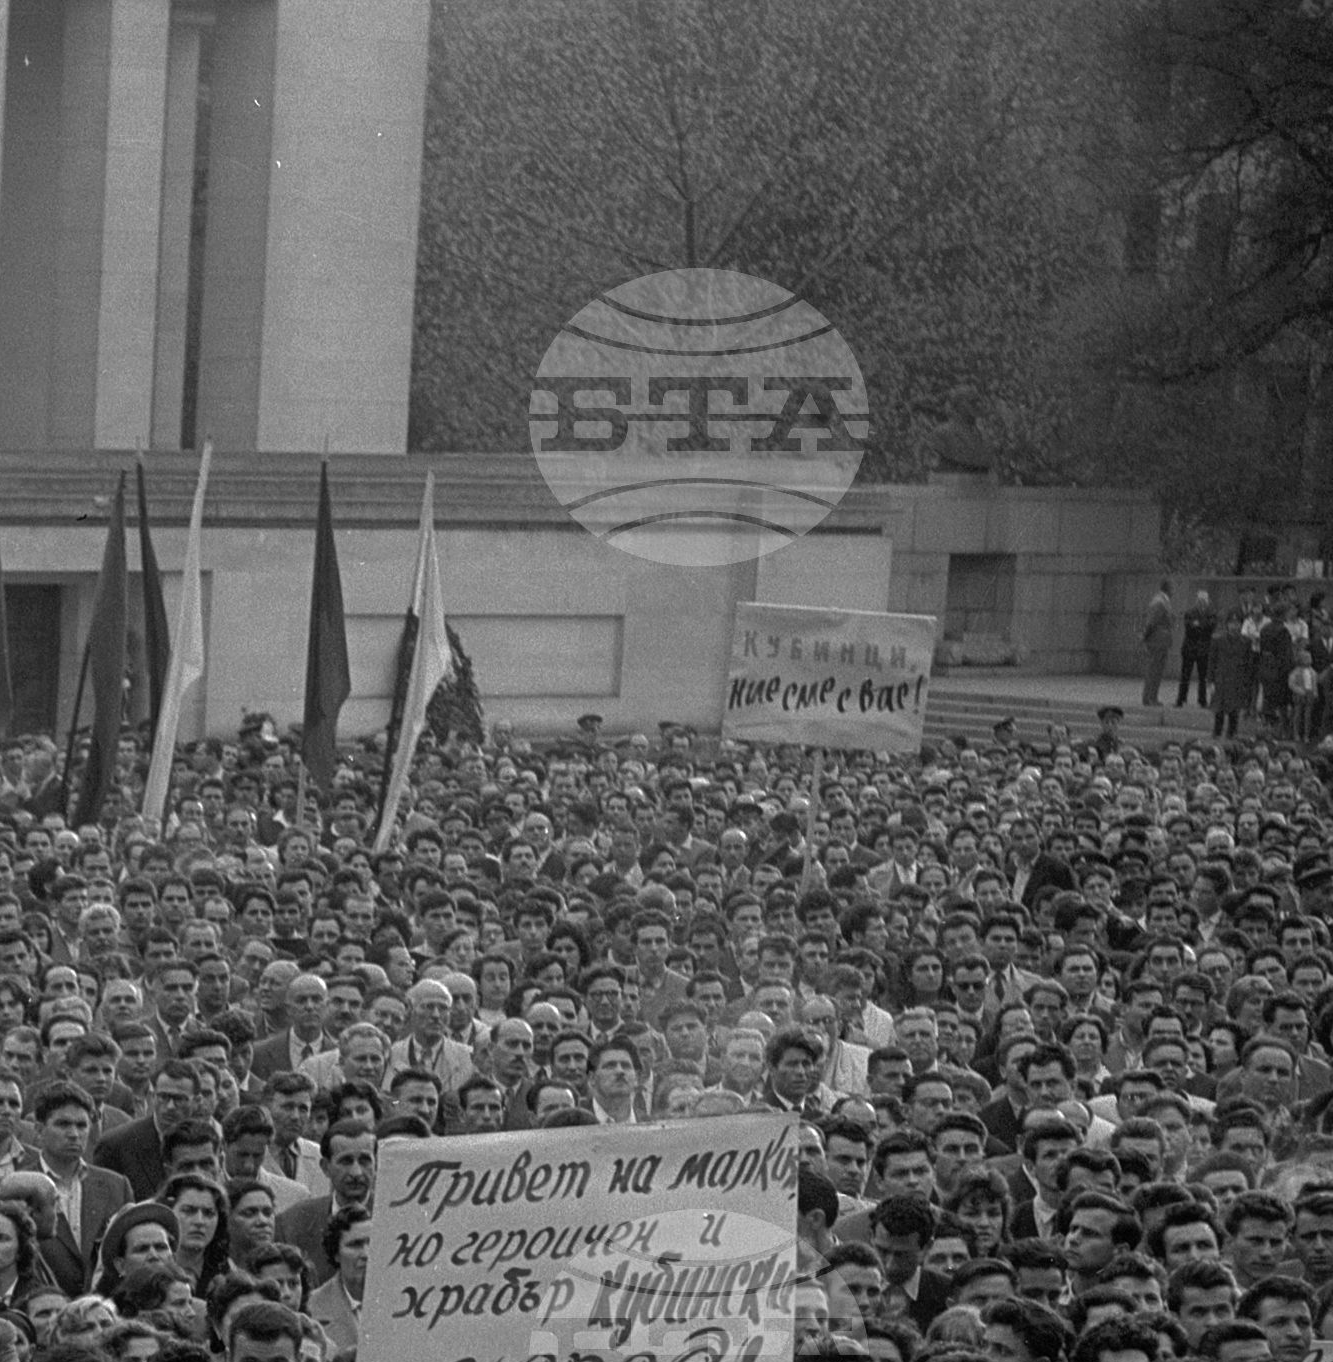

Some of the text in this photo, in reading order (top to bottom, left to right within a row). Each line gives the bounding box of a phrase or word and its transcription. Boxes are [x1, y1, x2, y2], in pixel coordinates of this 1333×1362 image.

[608, 1154, 663, 1194] на
[389, 1213, 727, 1271] но героичен и
[392, 1267, 575, 1330] храбър
